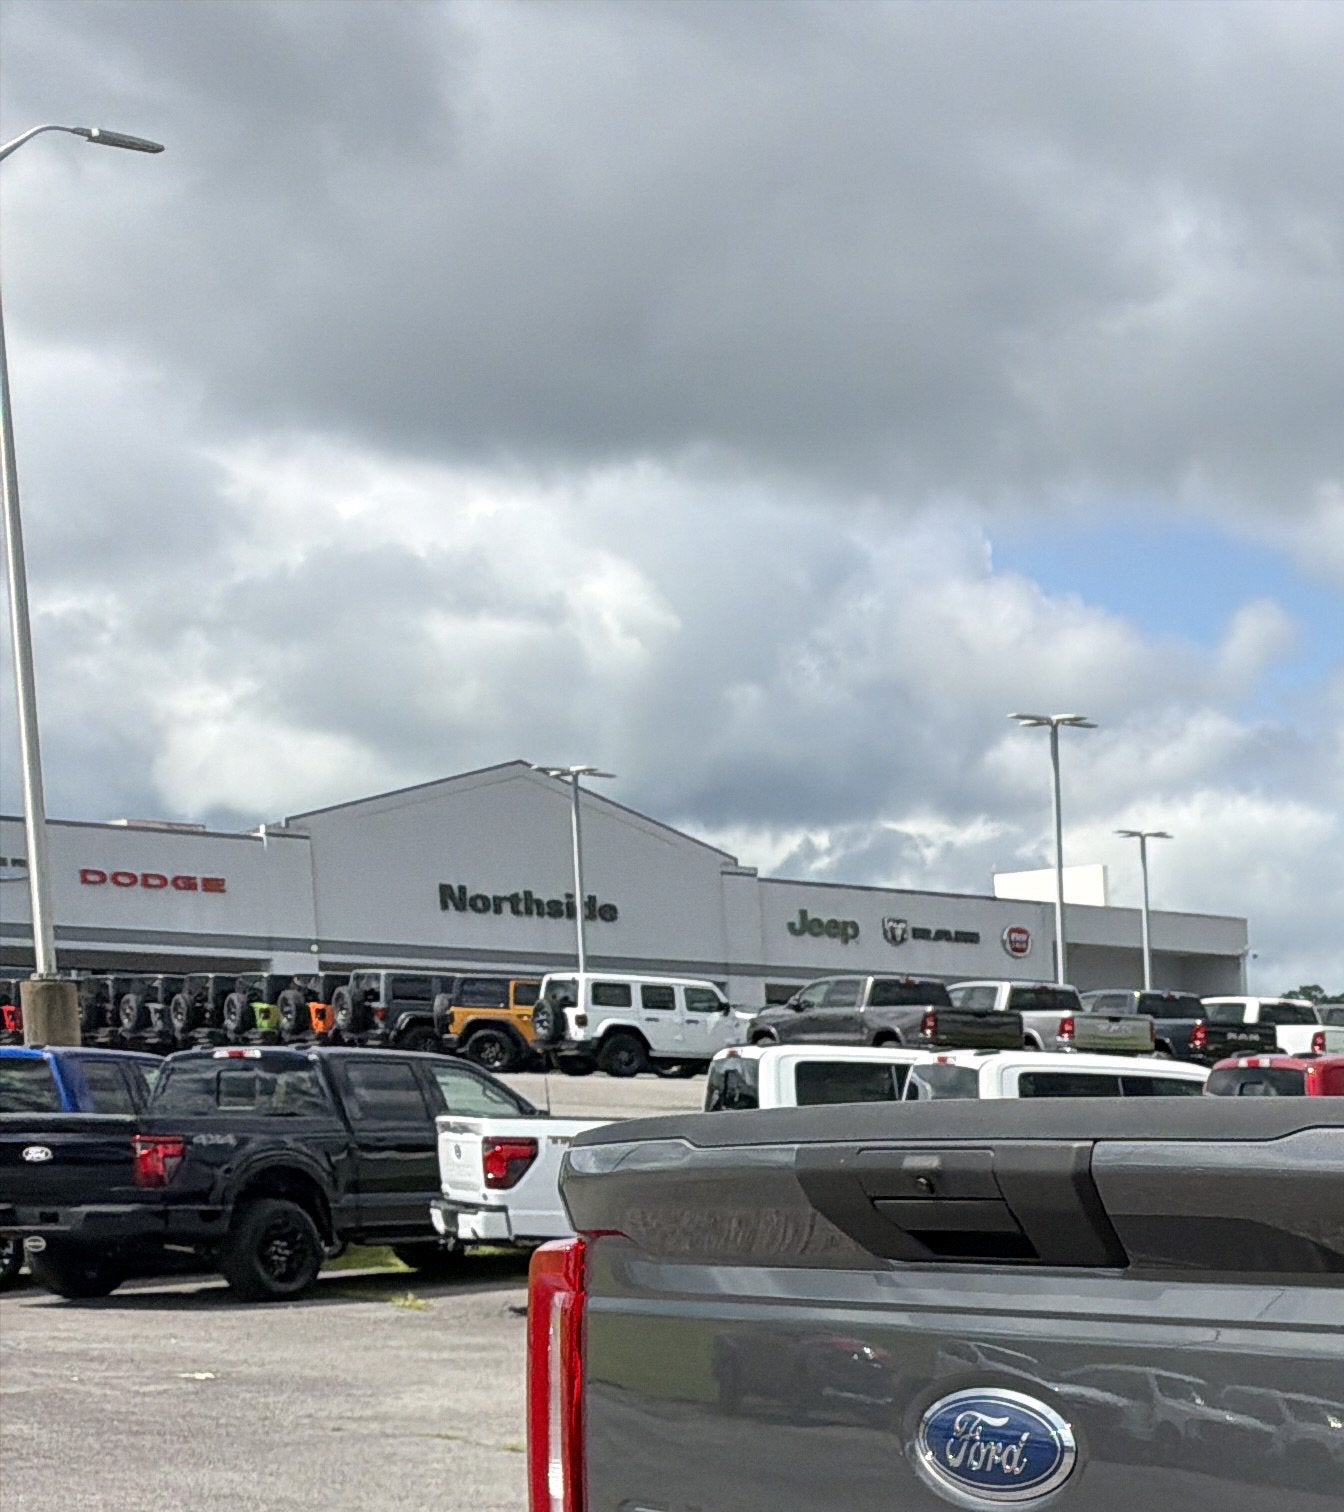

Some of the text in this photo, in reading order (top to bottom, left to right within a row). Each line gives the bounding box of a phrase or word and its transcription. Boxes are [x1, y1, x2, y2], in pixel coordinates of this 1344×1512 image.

[79, 868, 227, 893] DODGE
[438, 882, 619, 922] Northside
[787, 908, 860, 945] Jeep
[911, 926, 981, 944] RAM
[945, 1409, 1029, 1476] Ford
